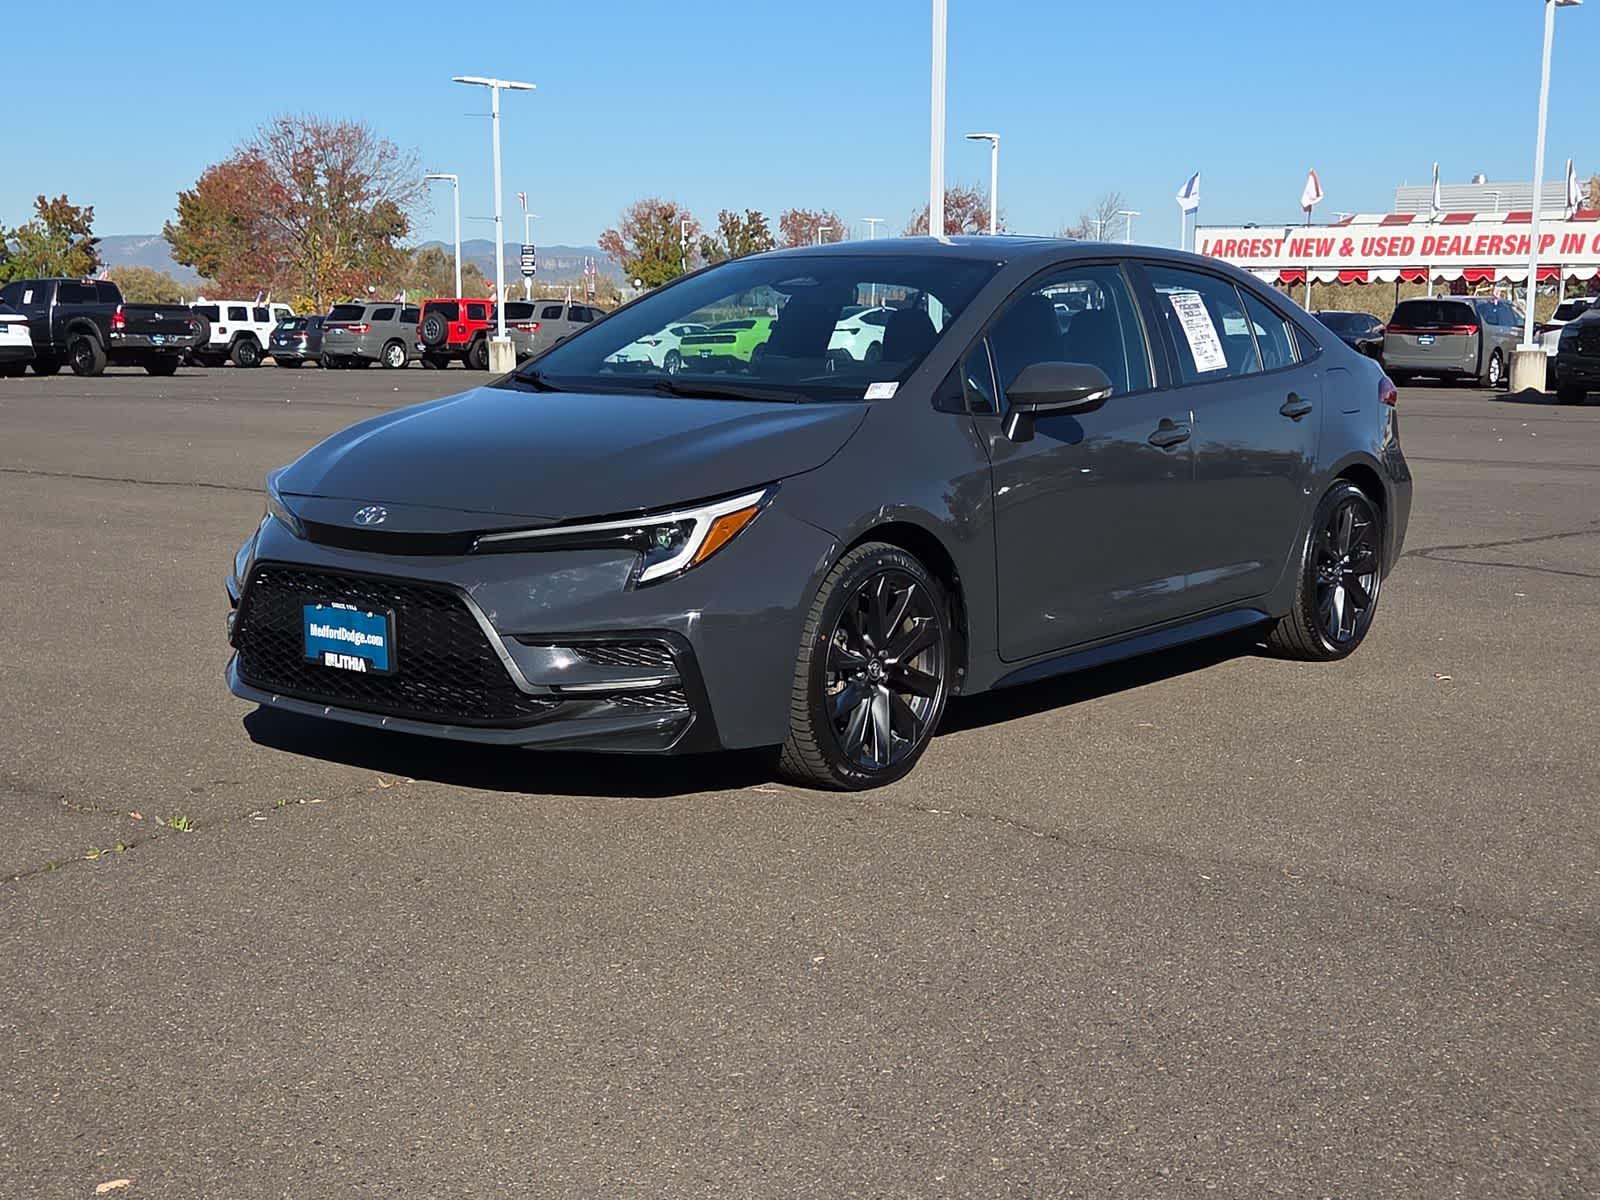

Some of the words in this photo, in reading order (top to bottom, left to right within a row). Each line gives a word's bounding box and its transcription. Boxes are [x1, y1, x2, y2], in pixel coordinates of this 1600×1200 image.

[1202, 238, 1285, 258] LARGEST
[1288, 237, 1336, 258] NEW
[1338, 237, 1355, 258] &
[1360, 235, 1416, 257] USED
[1420, 234, 1556, 257] DEALERSHP
[1559, 233, 1587, 254] IN
[310, 623, 384, 647] MedfordDodge.com
